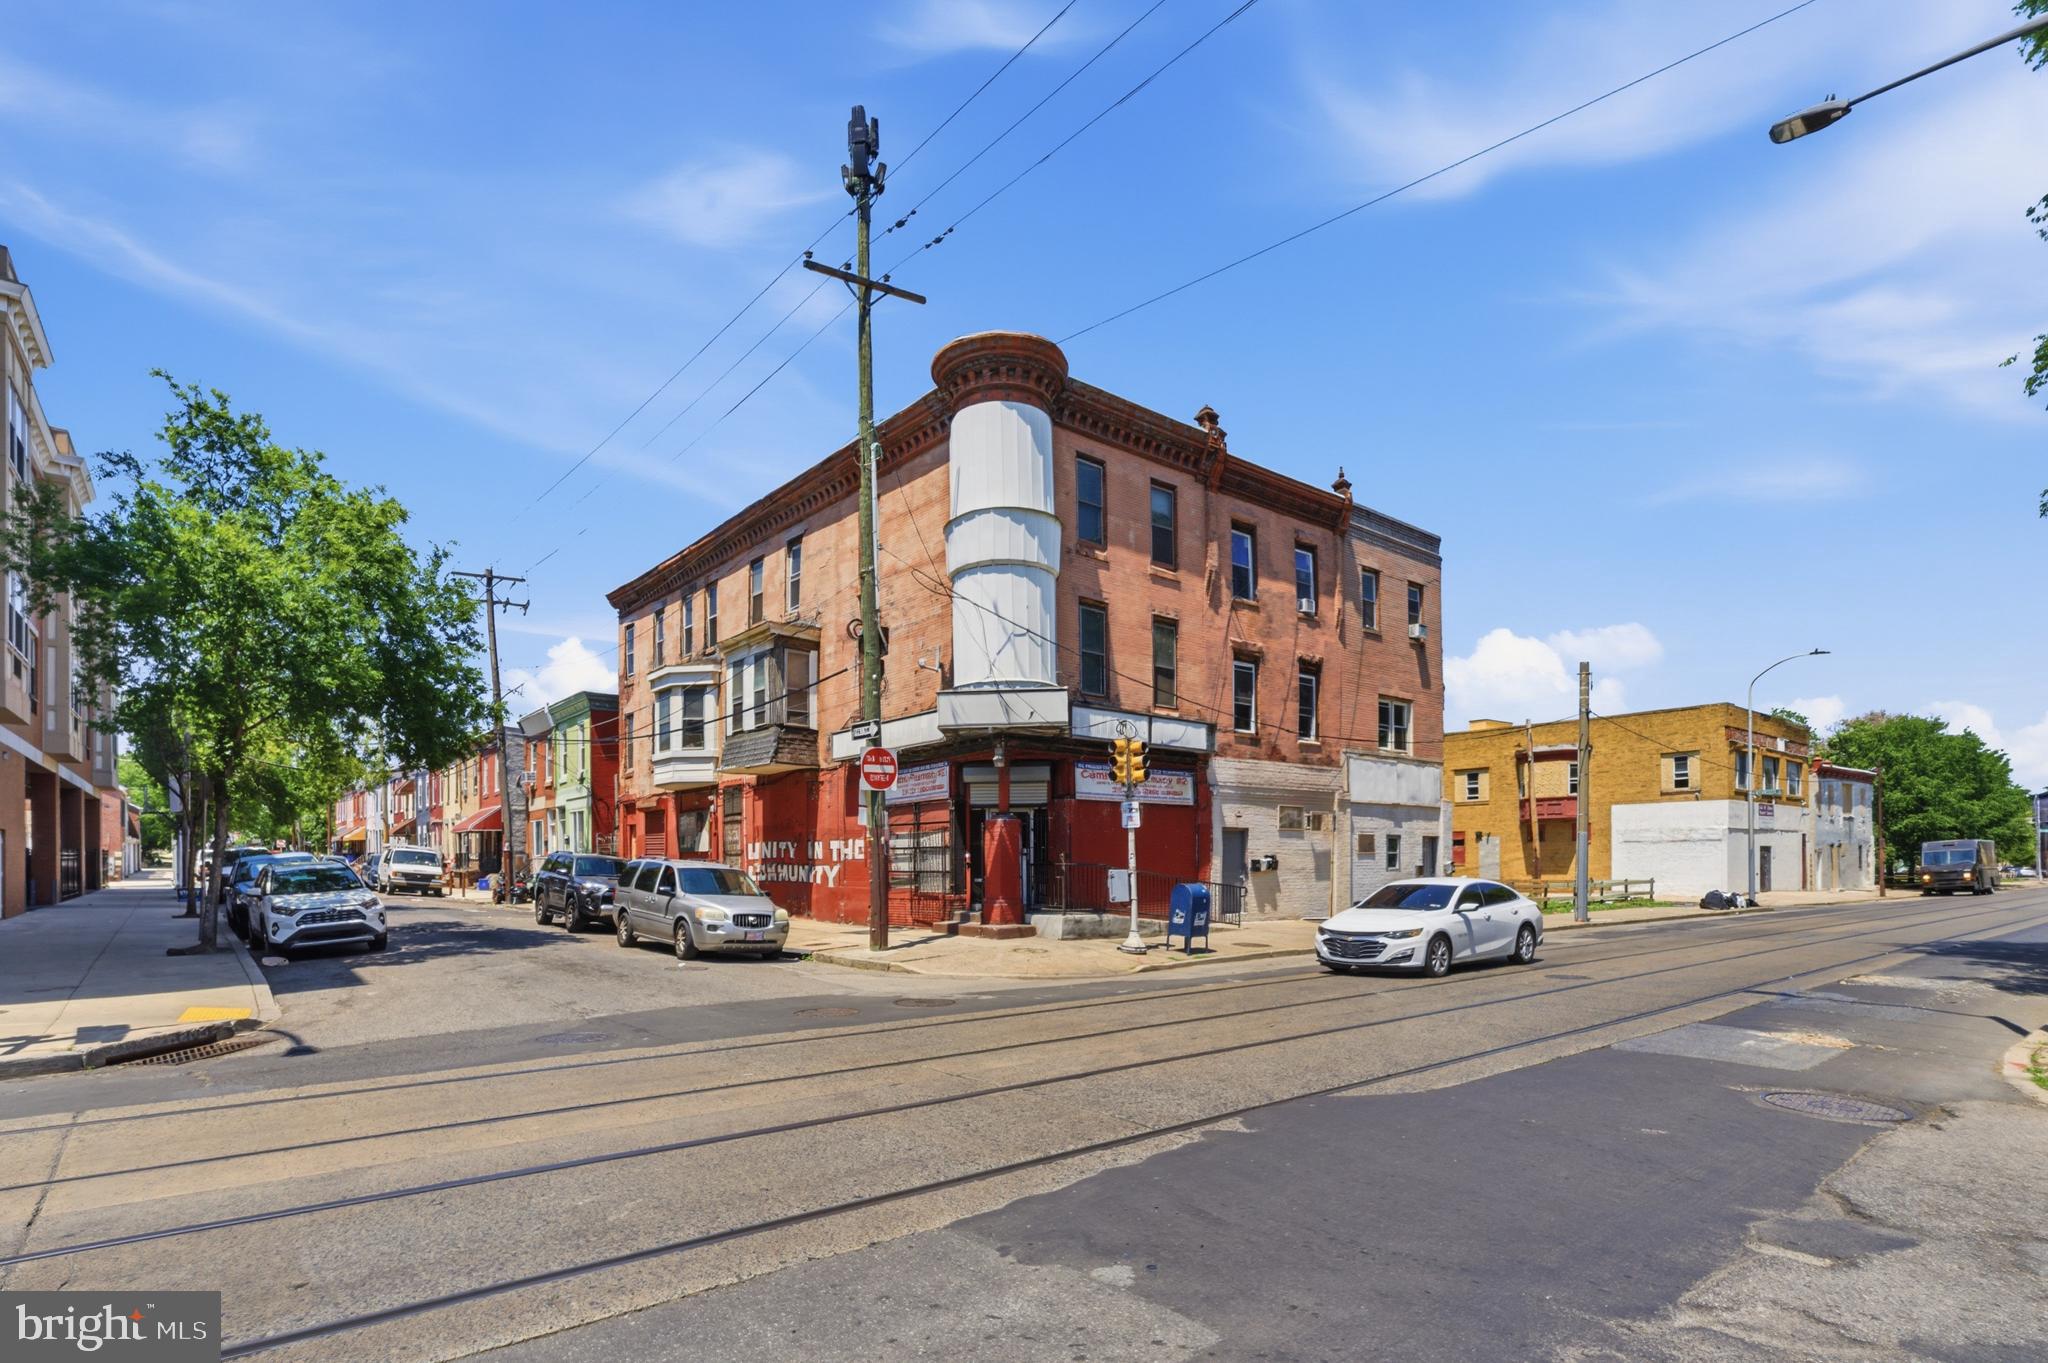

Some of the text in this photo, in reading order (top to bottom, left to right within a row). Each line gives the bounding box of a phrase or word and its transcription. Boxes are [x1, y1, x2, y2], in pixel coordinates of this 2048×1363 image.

[747, 838, 865, 862] UNITY IN THE
[747, 863, 841, 888] COMMUNITY
